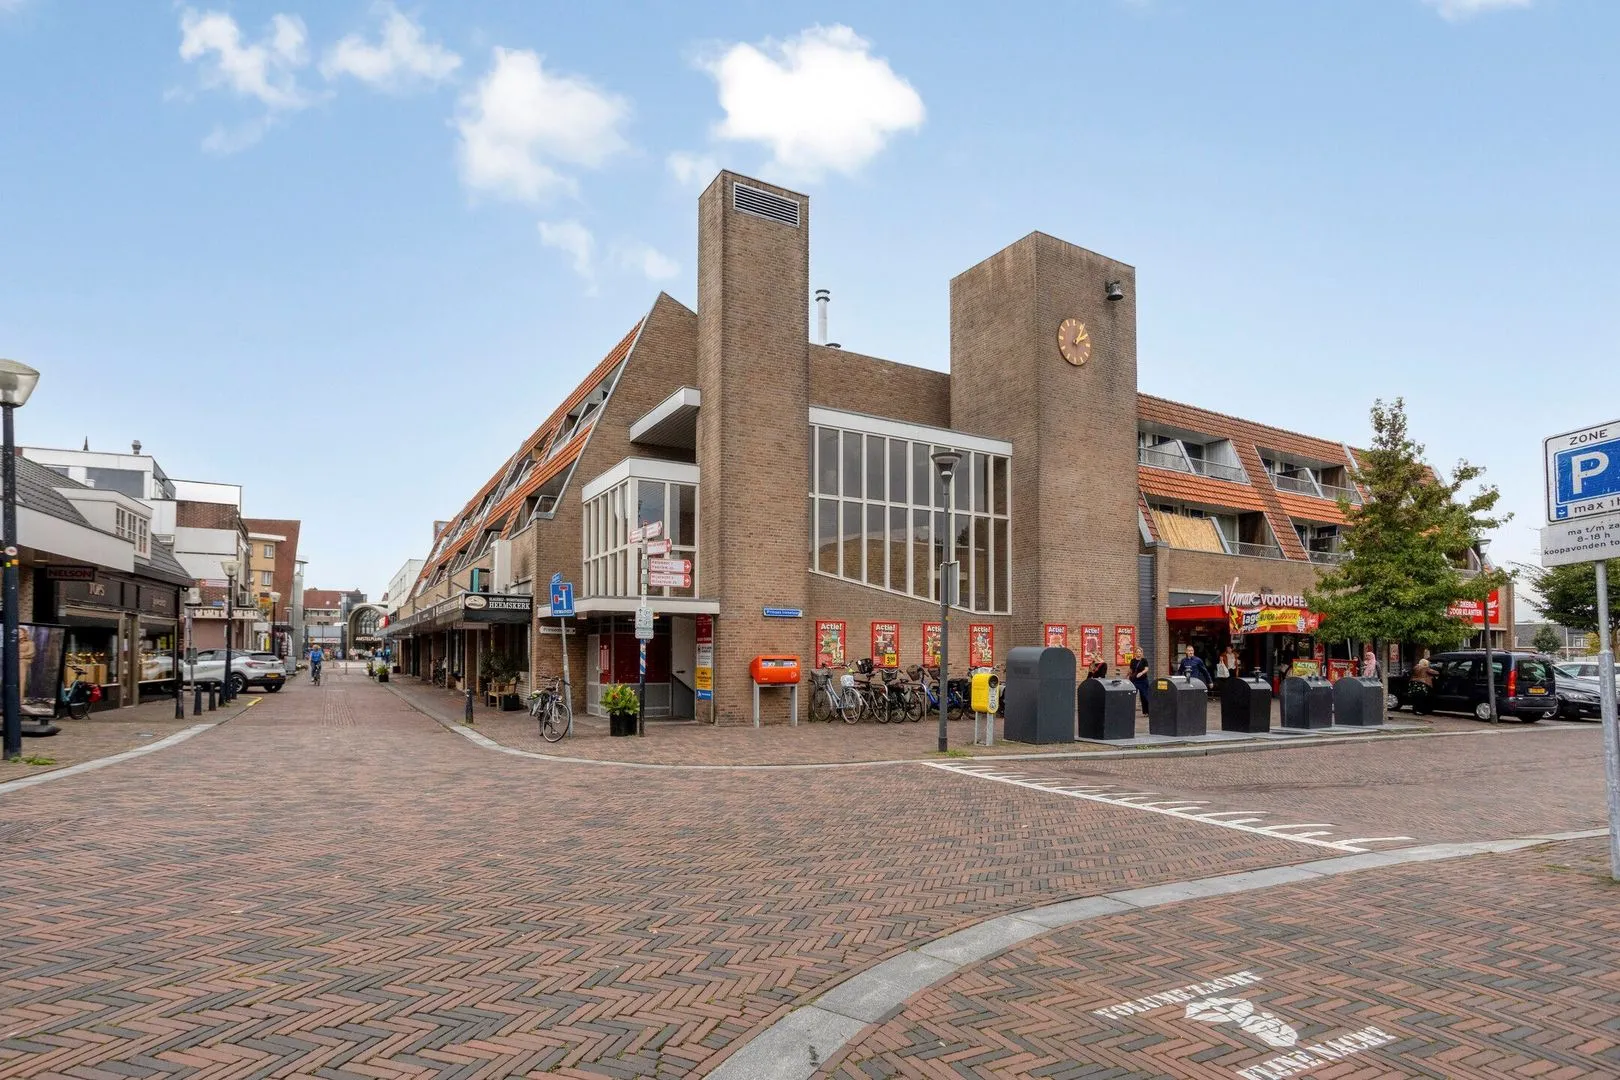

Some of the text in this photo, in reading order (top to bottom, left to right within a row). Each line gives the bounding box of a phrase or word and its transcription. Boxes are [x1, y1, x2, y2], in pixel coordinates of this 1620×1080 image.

[1569, 429, 1608, 446] ZONE
[1571, 451, 1609, 495] P
[1574, 501, 1604, 514] max
[1585, 523, 1605, 533] t/m
[1577, 531, 1611, 543] 8-18 h
[1543, 540, 1607, 556] koopavonden
[48, 567, 92, 578] NELSON
[489, 601, 530, 610] HEEMSKERK
[1462, 608, 1483, 617] KLANTEN
[821, 623, 842, 631] Actie!
[926, 625, 942, 633] Acti
[1048, 626, 1065, 634] Actie!
[1084, 627, 1100, 635] Actie!
[1117, 627, 1133, 635] Actie!
[1092, 970, 1263, 1020] VOLUME ZACHT
[1305, 1025, 1398, 1061] NACHT
